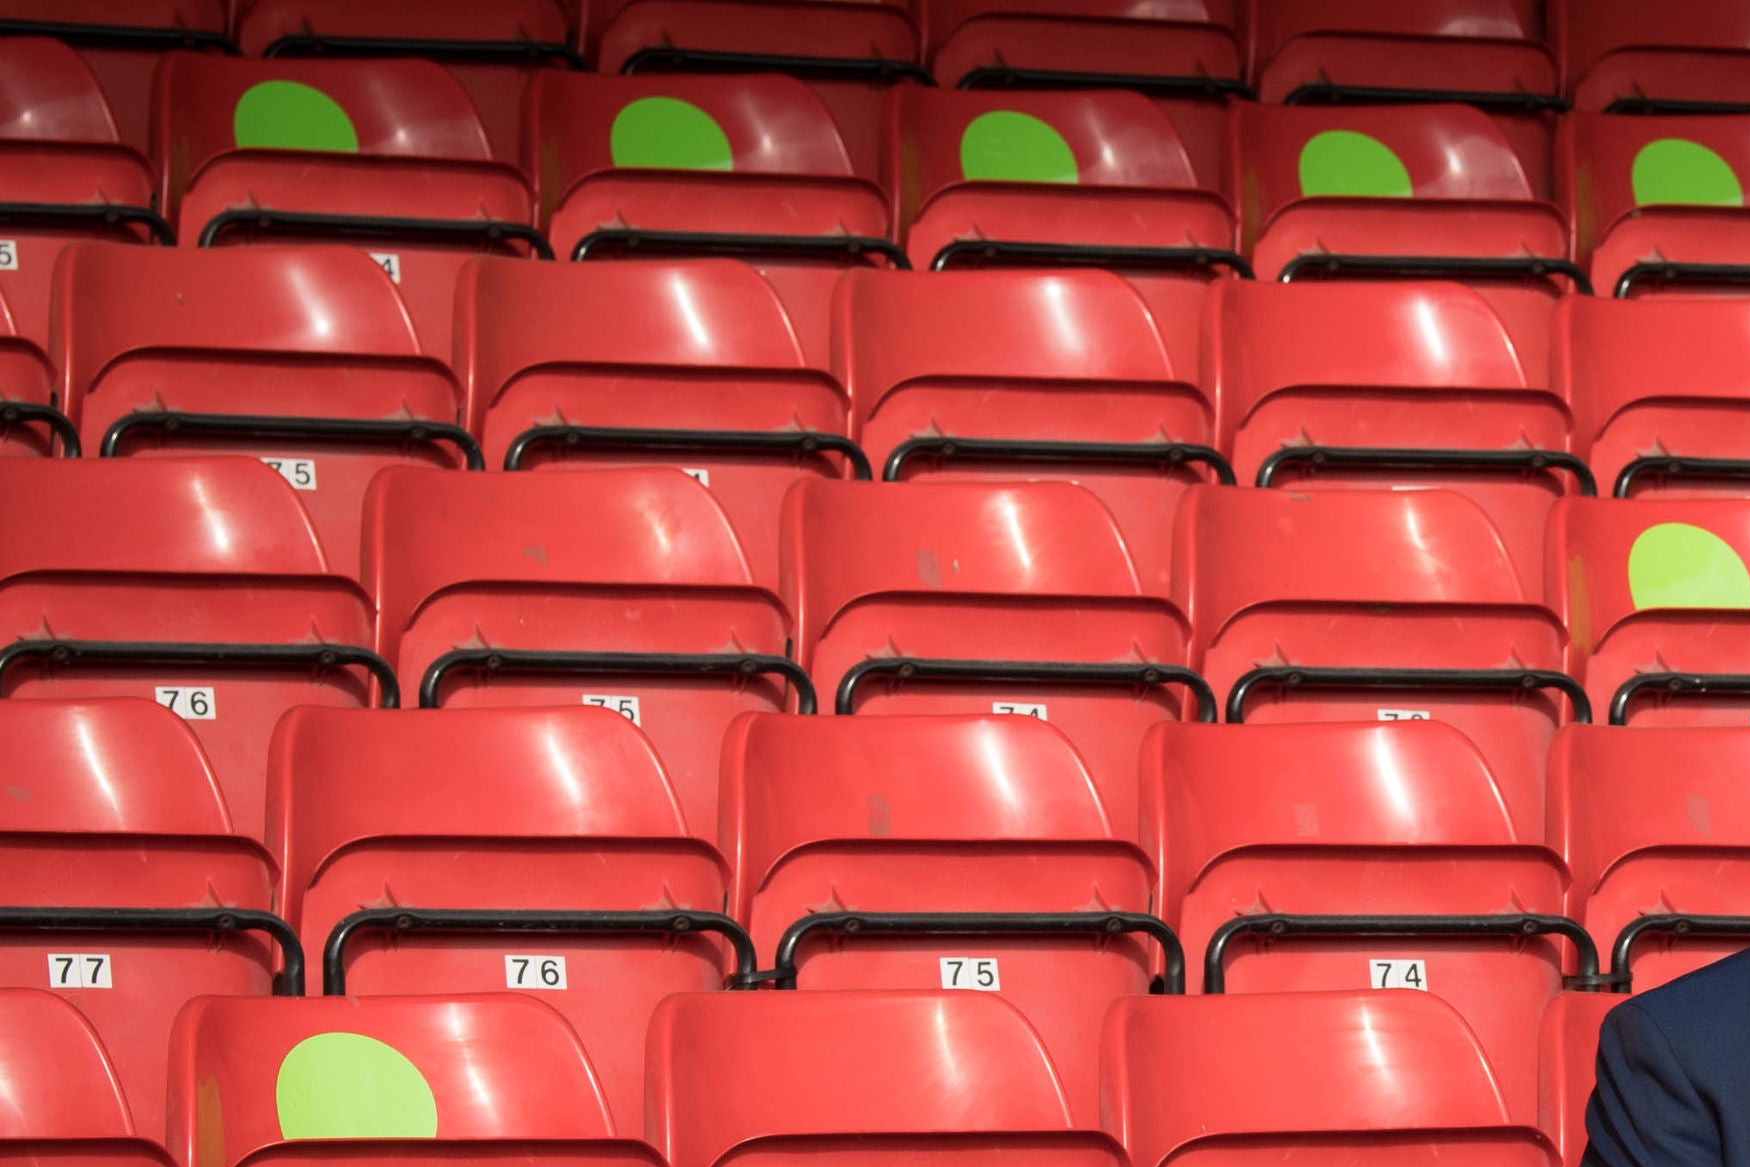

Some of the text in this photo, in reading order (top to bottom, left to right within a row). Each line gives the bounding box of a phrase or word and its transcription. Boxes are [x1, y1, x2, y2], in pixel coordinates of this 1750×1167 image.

[0, 245, 11, 264] 5
[163, 690, 208, 715] 76
[55, 957, 104, 984] 77
[512, 959, 560, 986] 76
[947, 961, 994, 987] 75
[1377, 963, 1422, 988] 74
